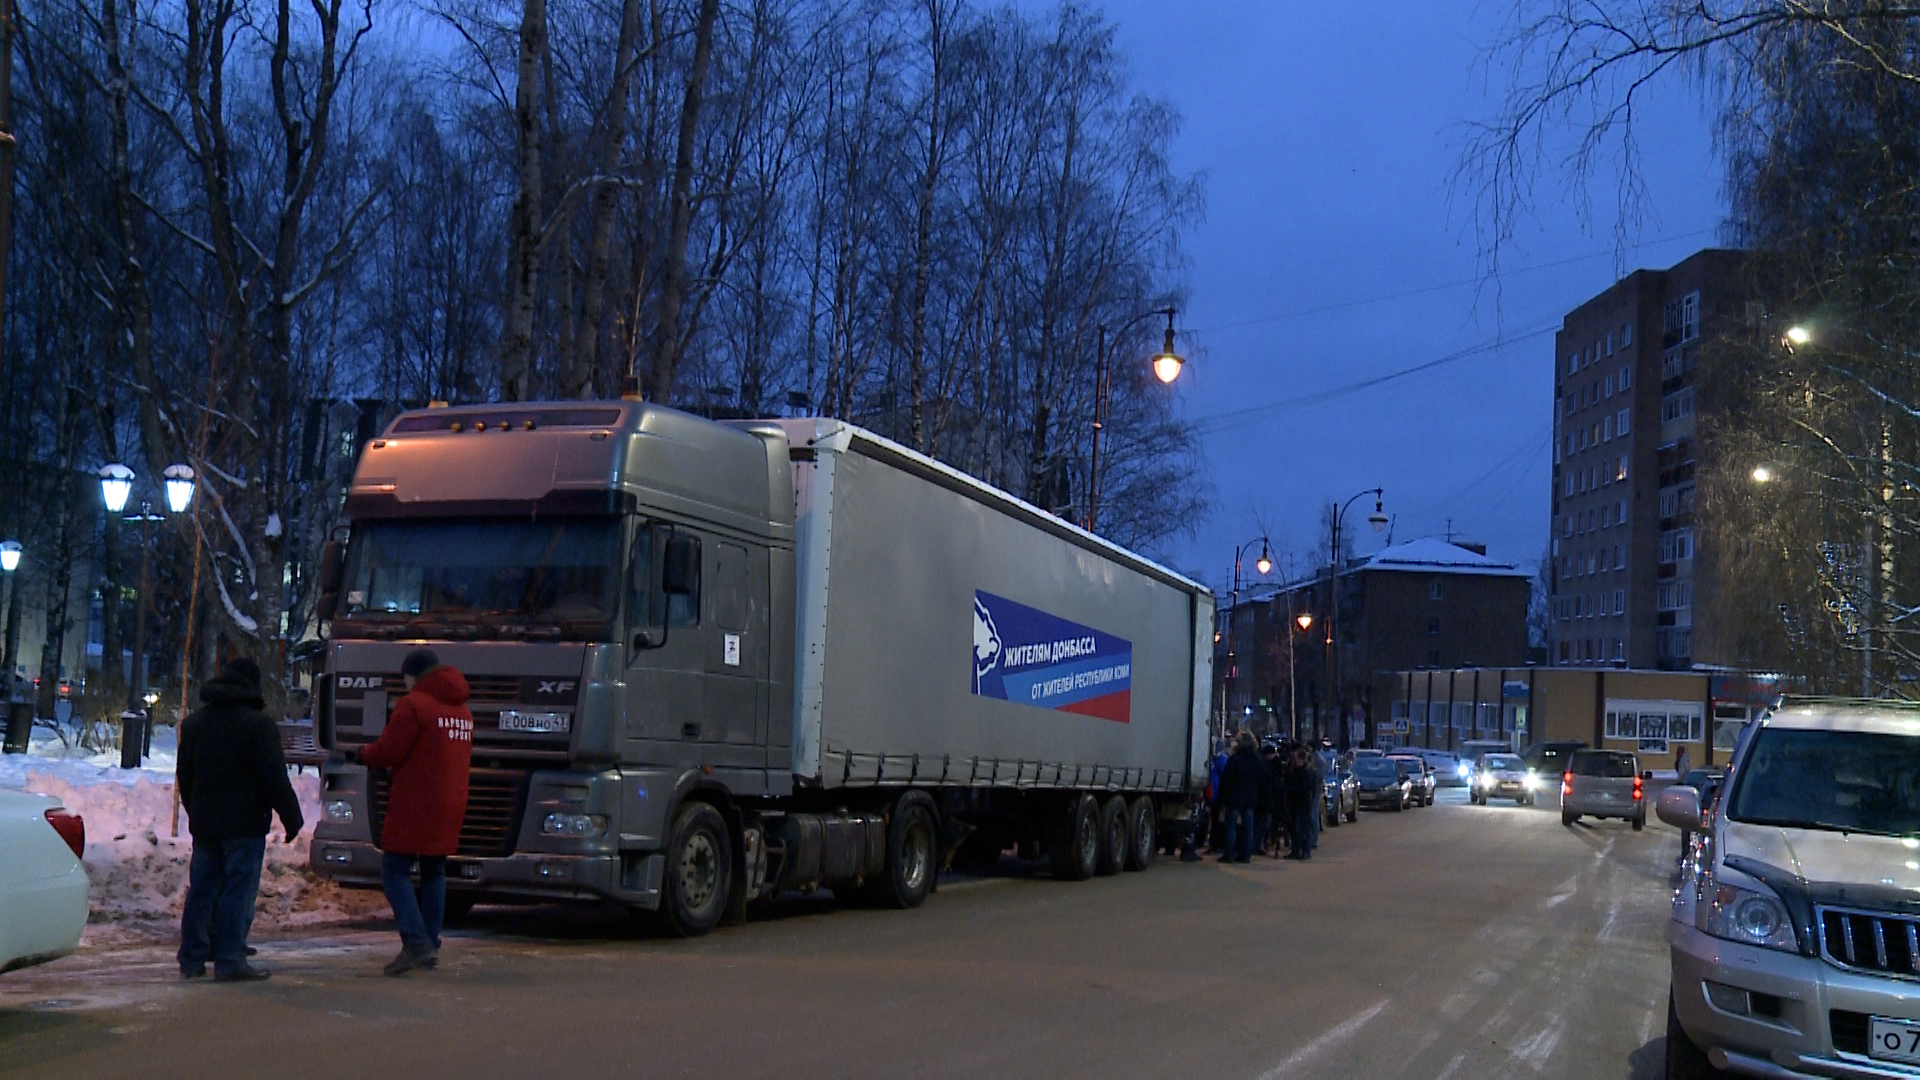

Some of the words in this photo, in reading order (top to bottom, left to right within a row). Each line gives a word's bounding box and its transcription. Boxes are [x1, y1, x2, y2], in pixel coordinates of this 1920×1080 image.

[1004, 642, 1051, 668] ЖИТЕЛЯМ
[1051, 636, 1096, 664] ДОНБАССА
[338, 677, 382, 688] DAF
[537, 681, 576, 693] XF
[1031, 683, 1042, 700] ОТ
[1043, 672, 1074, 697] ЖИТЕЛЕЙ
[1075, 667, 1114, 689] РЕСПУБЛИКИ
[1114, 663, 1130, 680] КОМИ
